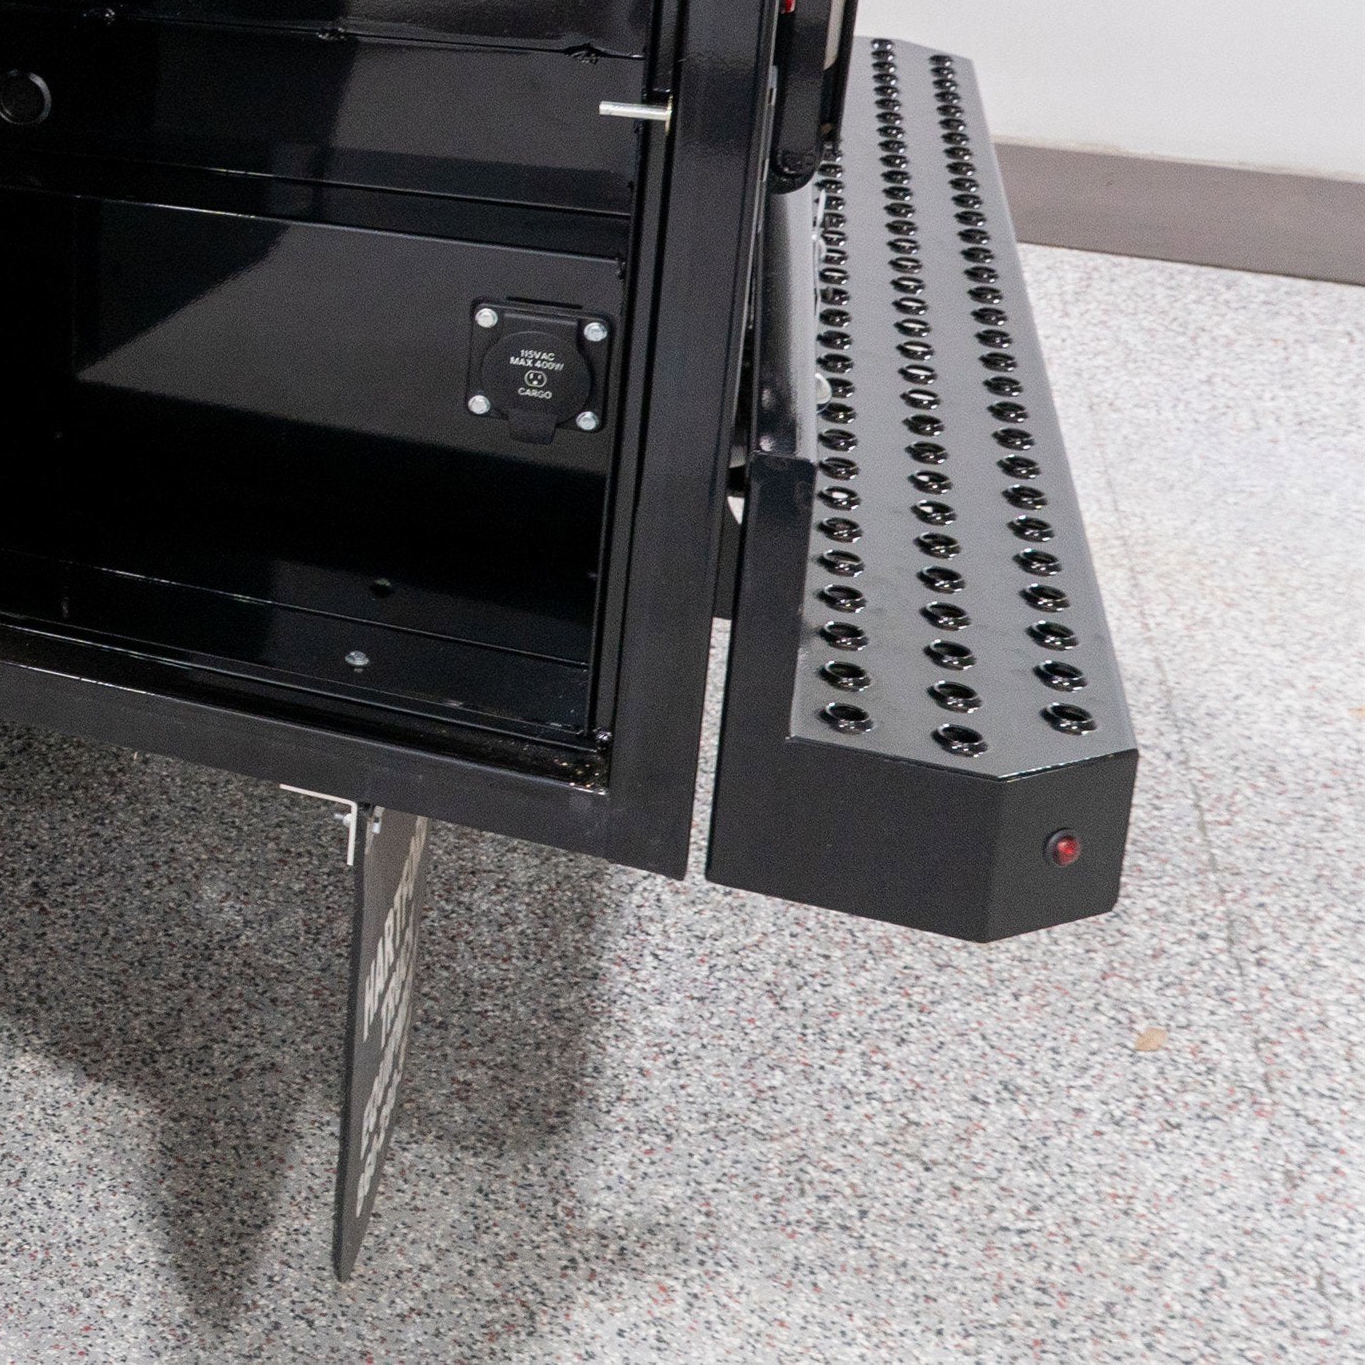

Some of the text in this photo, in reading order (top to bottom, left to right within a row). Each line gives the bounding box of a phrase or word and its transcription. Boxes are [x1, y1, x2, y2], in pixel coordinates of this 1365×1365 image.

[520, 349, 555, 361] 115VAC
[509, 356, 565, 371] MAX 400W
[517, 387, 553, 399] CARGO
